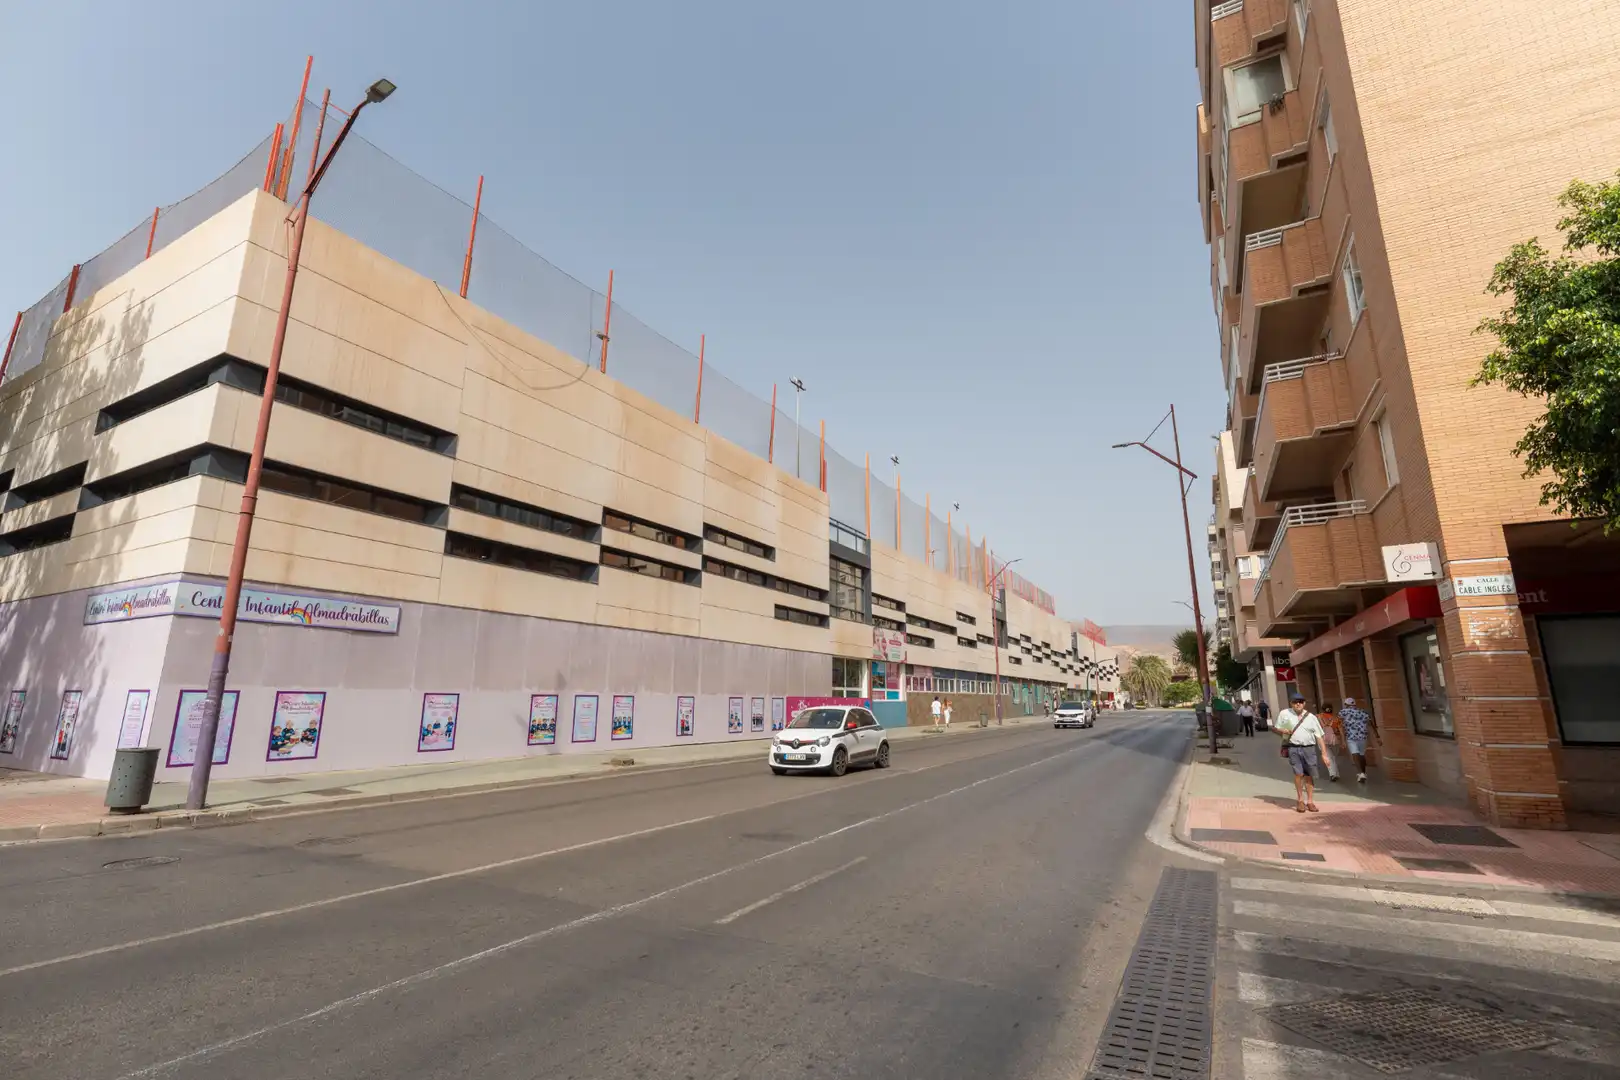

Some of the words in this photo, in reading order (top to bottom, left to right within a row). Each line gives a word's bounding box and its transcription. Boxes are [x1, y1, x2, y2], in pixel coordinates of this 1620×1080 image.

[1458, 586, 1483, 594] CABLE
[191, 590, 240, 609] Cent
[245, 595, 300, 616] Infantil
[302, 602, 390, 626] Almadrabillas
